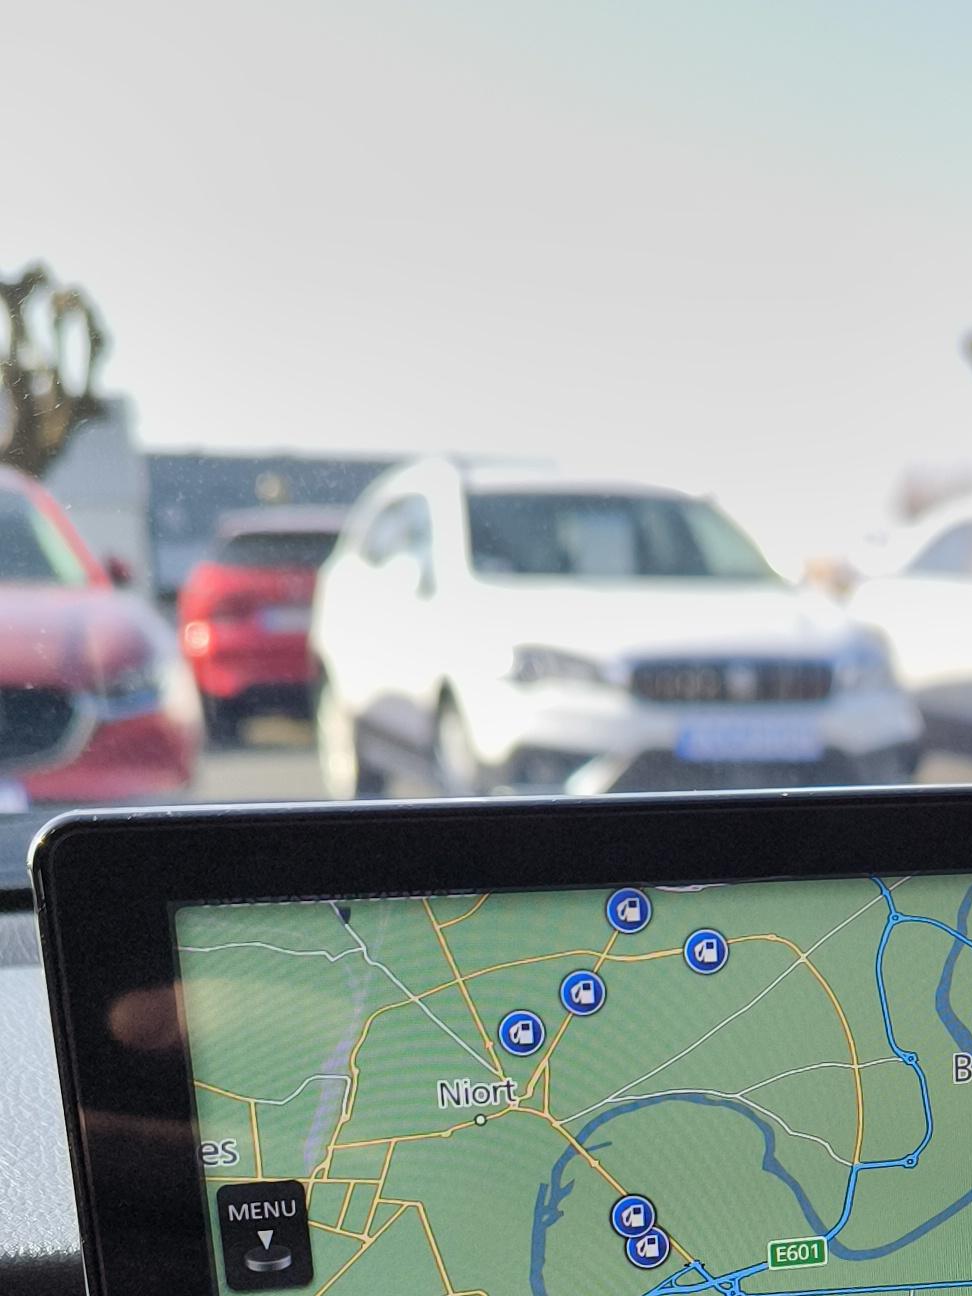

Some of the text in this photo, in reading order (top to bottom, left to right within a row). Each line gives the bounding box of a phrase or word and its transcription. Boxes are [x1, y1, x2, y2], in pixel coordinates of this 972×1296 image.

[438, 1078, 517, 1108] Niort
[227, 1199, 297, 1222] MENU
[775, 1244, 821, 1263] E601
